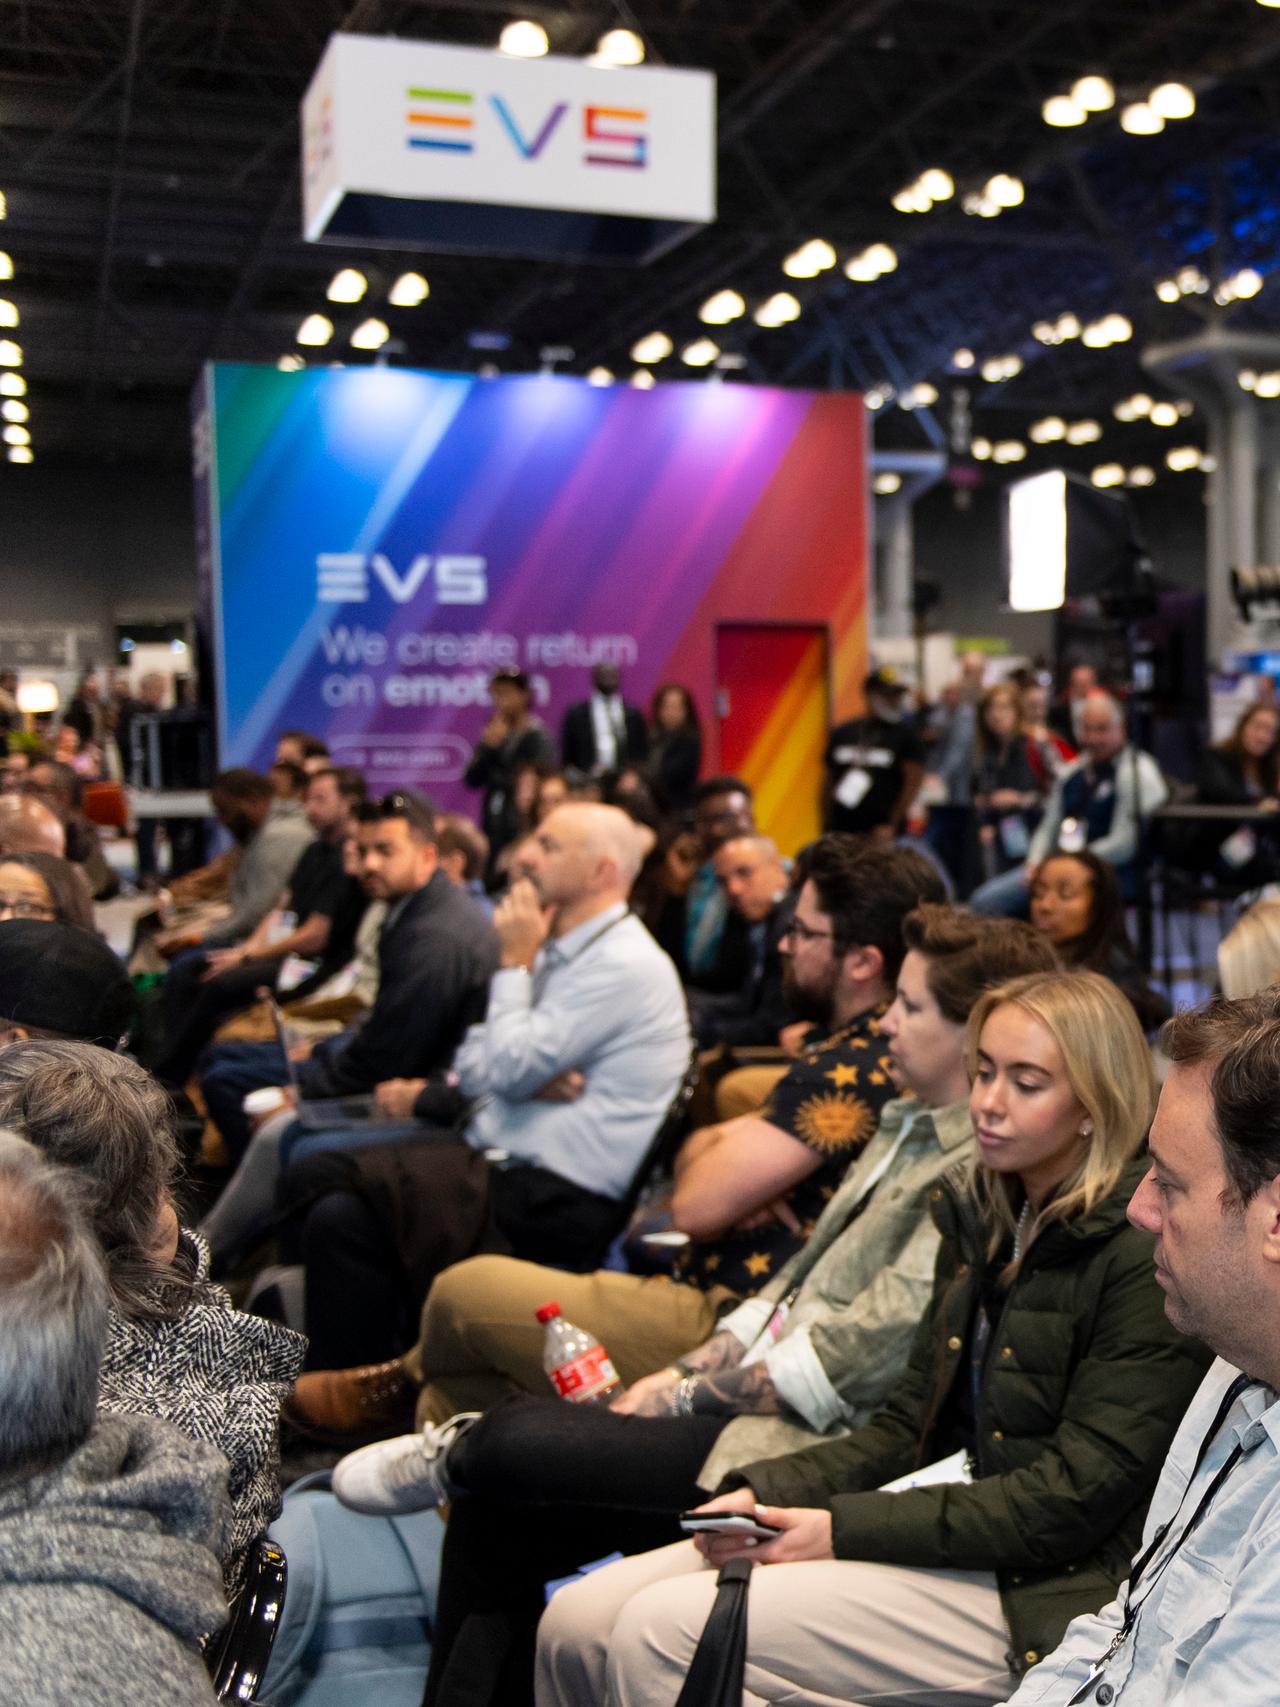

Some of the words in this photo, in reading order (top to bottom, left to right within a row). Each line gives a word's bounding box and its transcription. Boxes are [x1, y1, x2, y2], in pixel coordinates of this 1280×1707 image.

[406, 86, 648, 169] EVS
[316, 552, 488, 604] EVS
[322, 625, 389, 667] We
[397, 632, 519, 668] create
[526, 632, 639, 668] return
[322, 673, 375, 708] on
[383, 670, 549, 708] emotn
